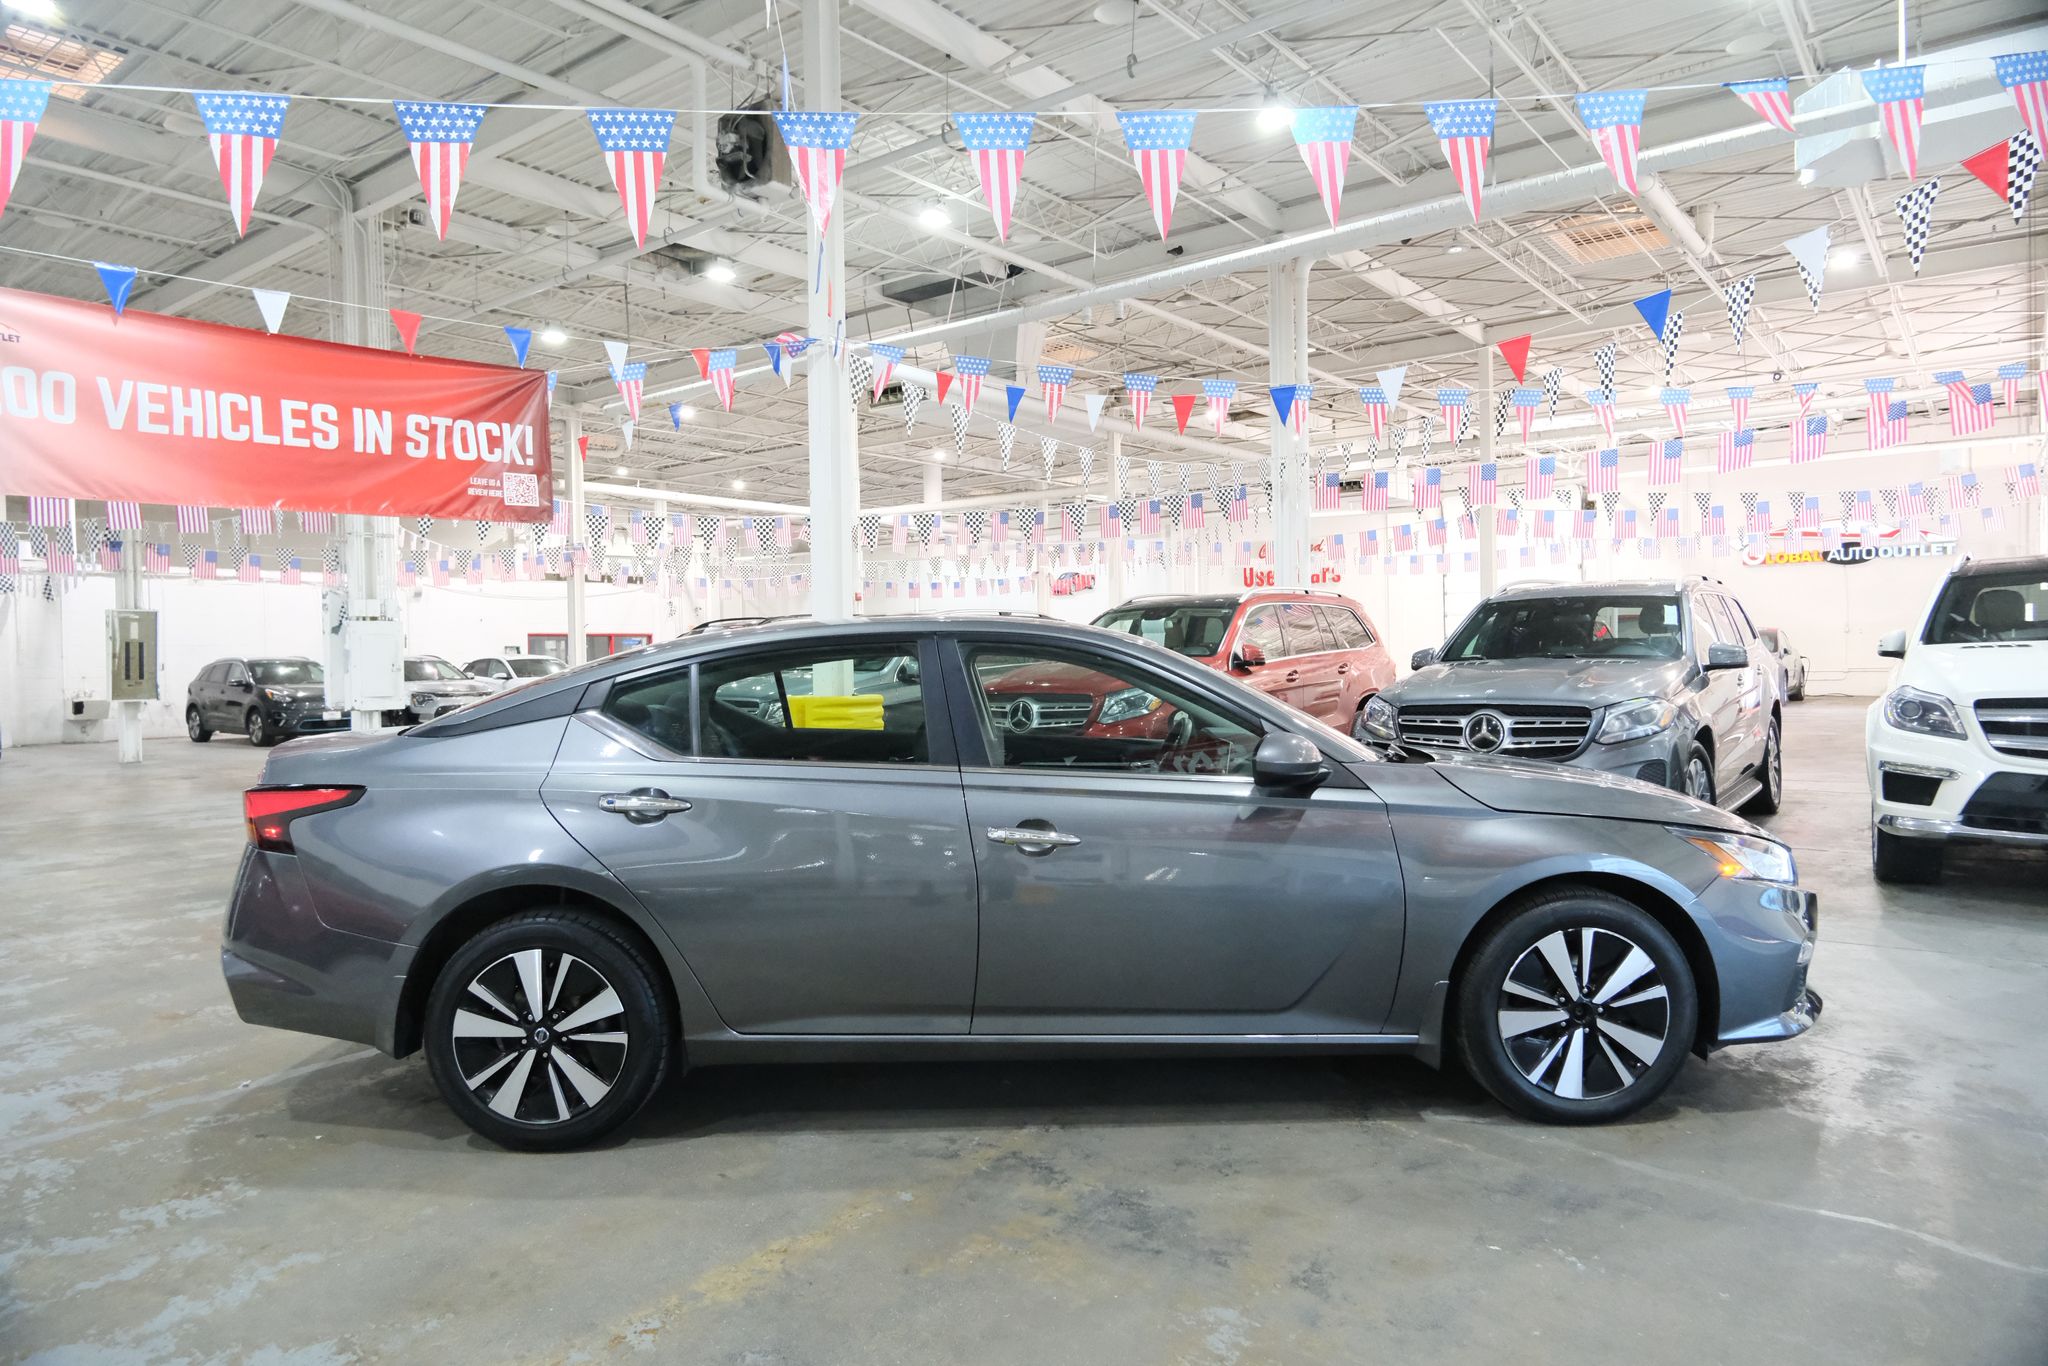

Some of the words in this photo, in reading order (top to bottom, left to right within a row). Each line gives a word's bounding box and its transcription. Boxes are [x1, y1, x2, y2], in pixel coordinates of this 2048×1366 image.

[96, 376, 339, 450] VEHICLES
[352, 407, 392, 456] IN
[405, 414, 534, 466] STOCK!
[1827, 545, 1877, 561] AUTO
[1878, 543, 1957, 558] OUTLET
[1243, 567, 1276, 588] Use
